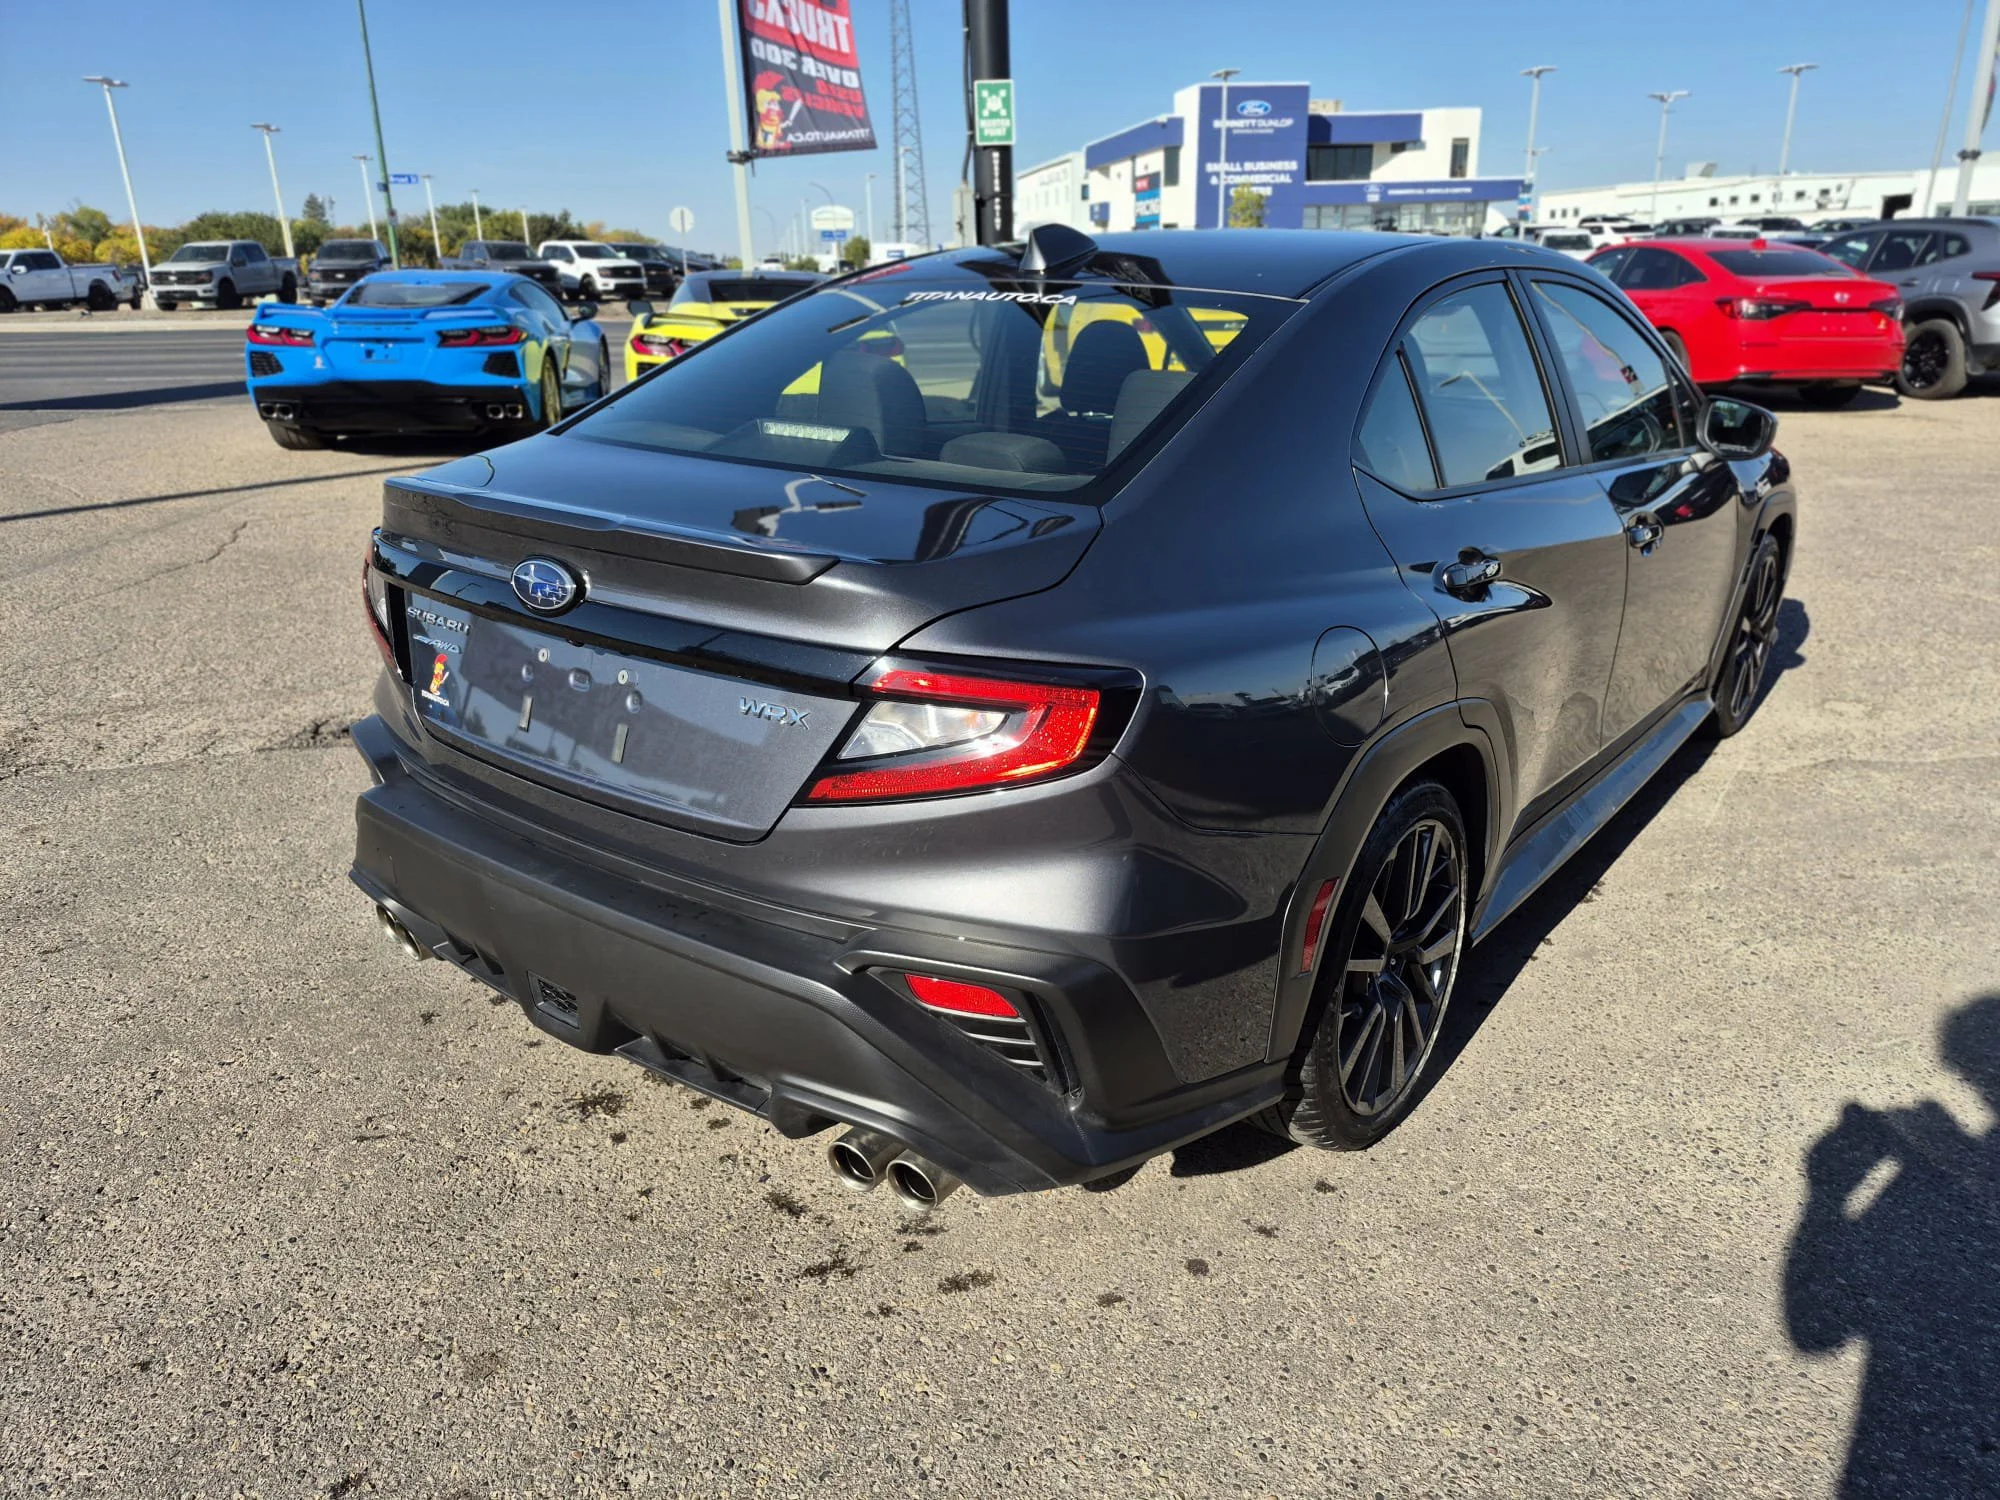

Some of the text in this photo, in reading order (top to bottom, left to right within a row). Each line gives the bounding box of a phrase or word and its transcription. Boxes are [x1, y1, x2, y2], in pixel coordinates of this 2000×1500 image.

[905, 291, 1078, 305] TITANAUTO.CA
[407, 606, 470, 635] SUBARU
[740, 696, 810, 730] WRX
